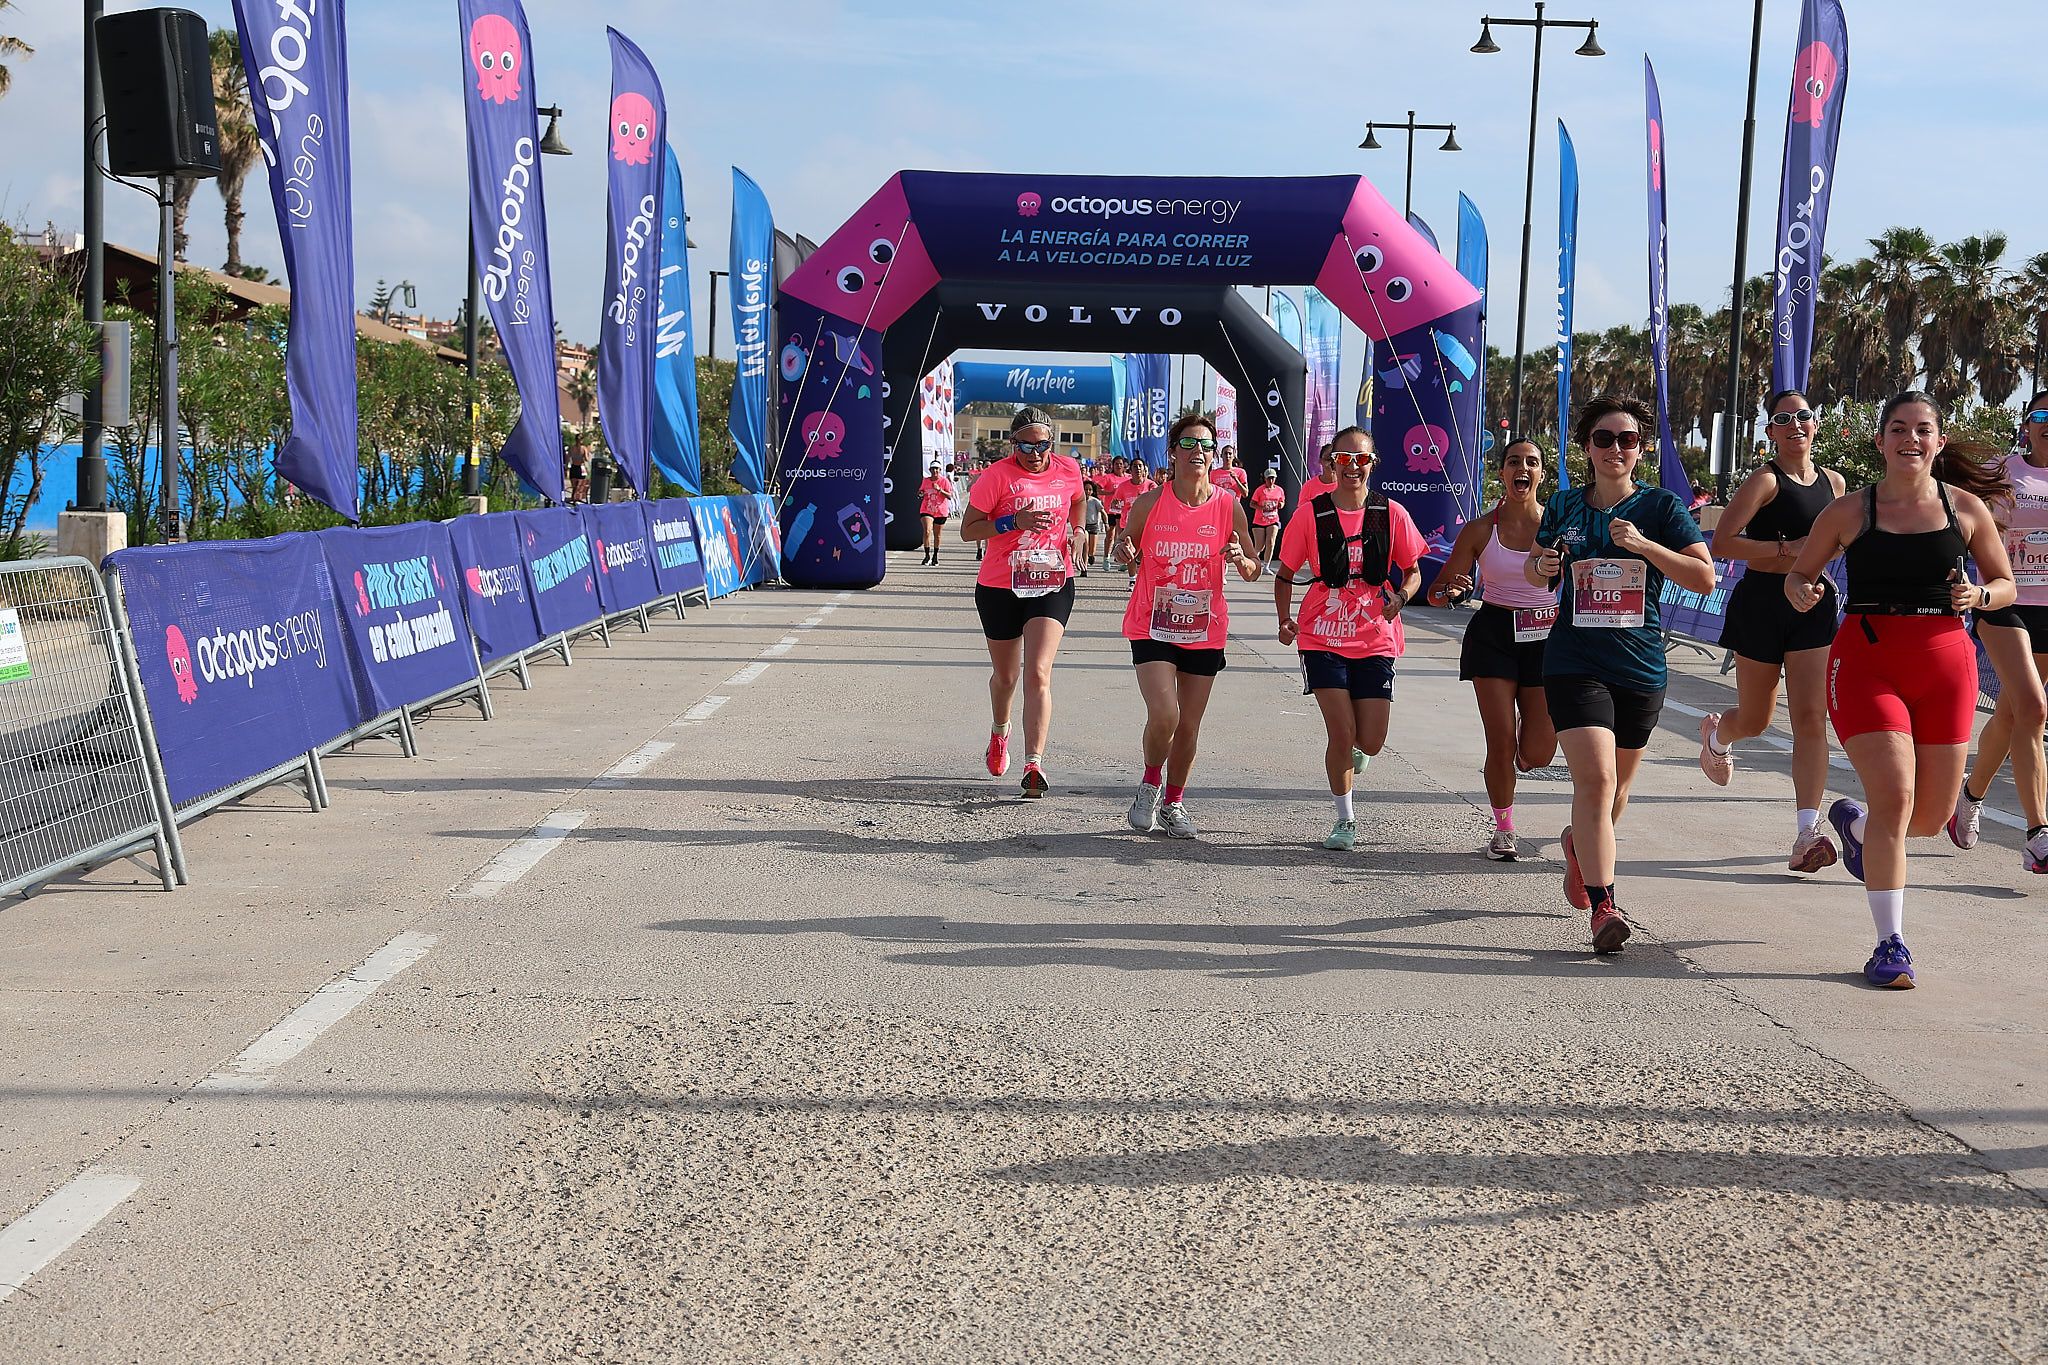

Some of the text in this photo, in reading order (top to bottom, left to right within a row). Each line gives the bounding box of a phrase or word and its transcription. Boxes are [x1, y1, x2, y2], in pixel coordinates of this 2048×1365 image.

[1051, 196, 1242, 224] octopus energy
[1000, 228, 1250, 249] LA ENERGÍA PARA CORRER
[997, 250, 1252, 267] A LA VELOCIDAD DE LA LUZ
[977, 303, 1182, 326] VOLVO
[1006, 368, 1075, 398] Marlene
[785, 467, 868, 481] octopus energy
[1381, 480, 1467, 496] octopus energy
[1154, 524, 1179, 533] OYSHO
[1030, 571, 1050, 579] 016
[1593, 590, 1622, 602] 016
[1171, 613, 1194, 624] 016
[1535, 608, 1556, 619] 016
[1917, 607, 1942, 615] KIPRUN
[1313, 619, 1357, 638] MUJER
[196, 608, 329, 689] octopus energy
[368, 625, 389, 664] en
